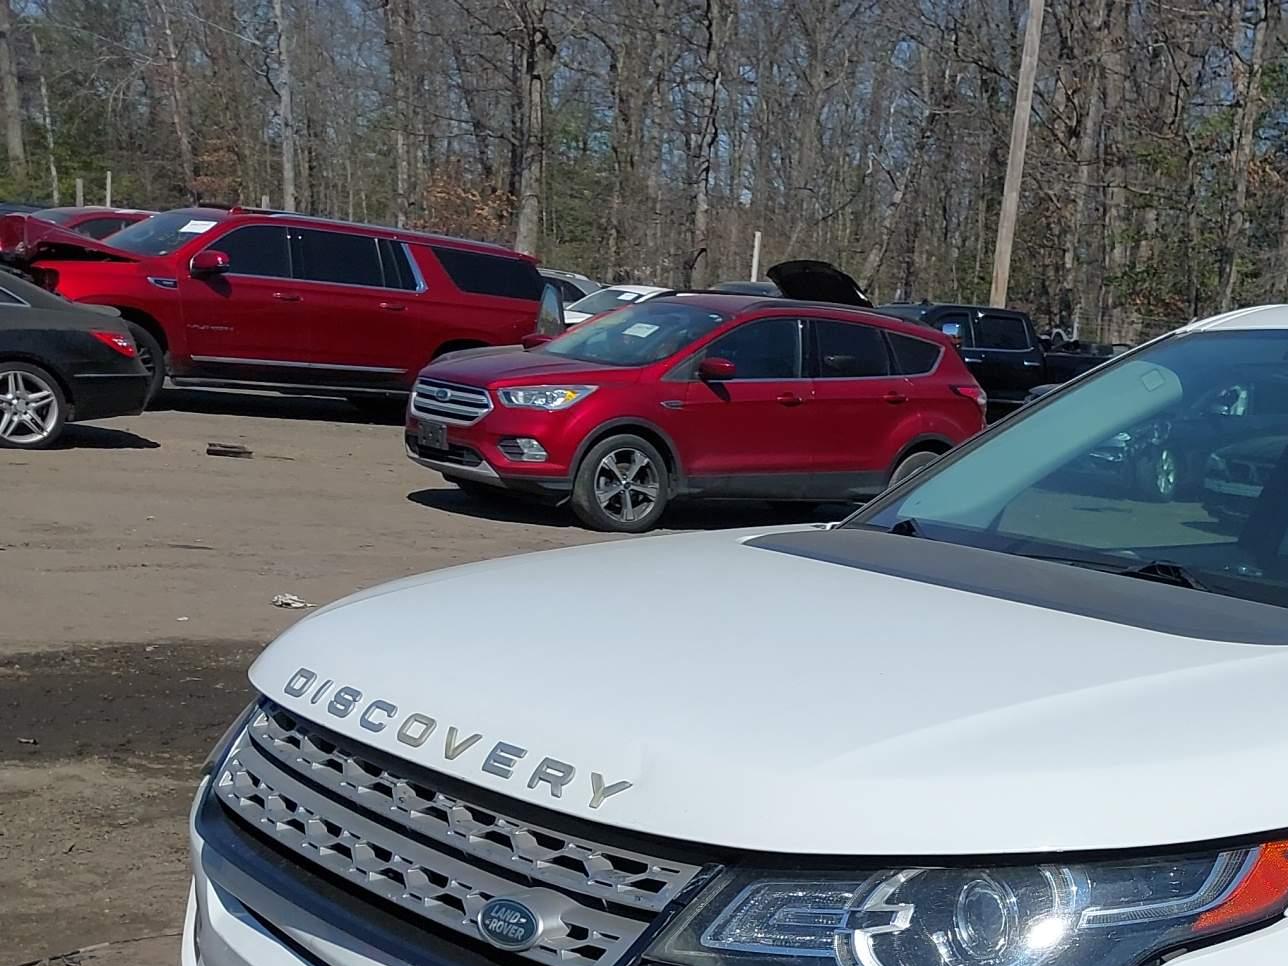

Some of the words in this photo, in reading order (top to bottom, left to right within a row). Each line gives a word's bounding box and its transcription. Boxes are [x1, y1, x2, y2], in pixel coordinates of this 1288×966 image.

[284, 667, 633, 809] DISCOVERY
[490, 904, 521, 924] LAND
[488, 918, 526, 941] ROVER
